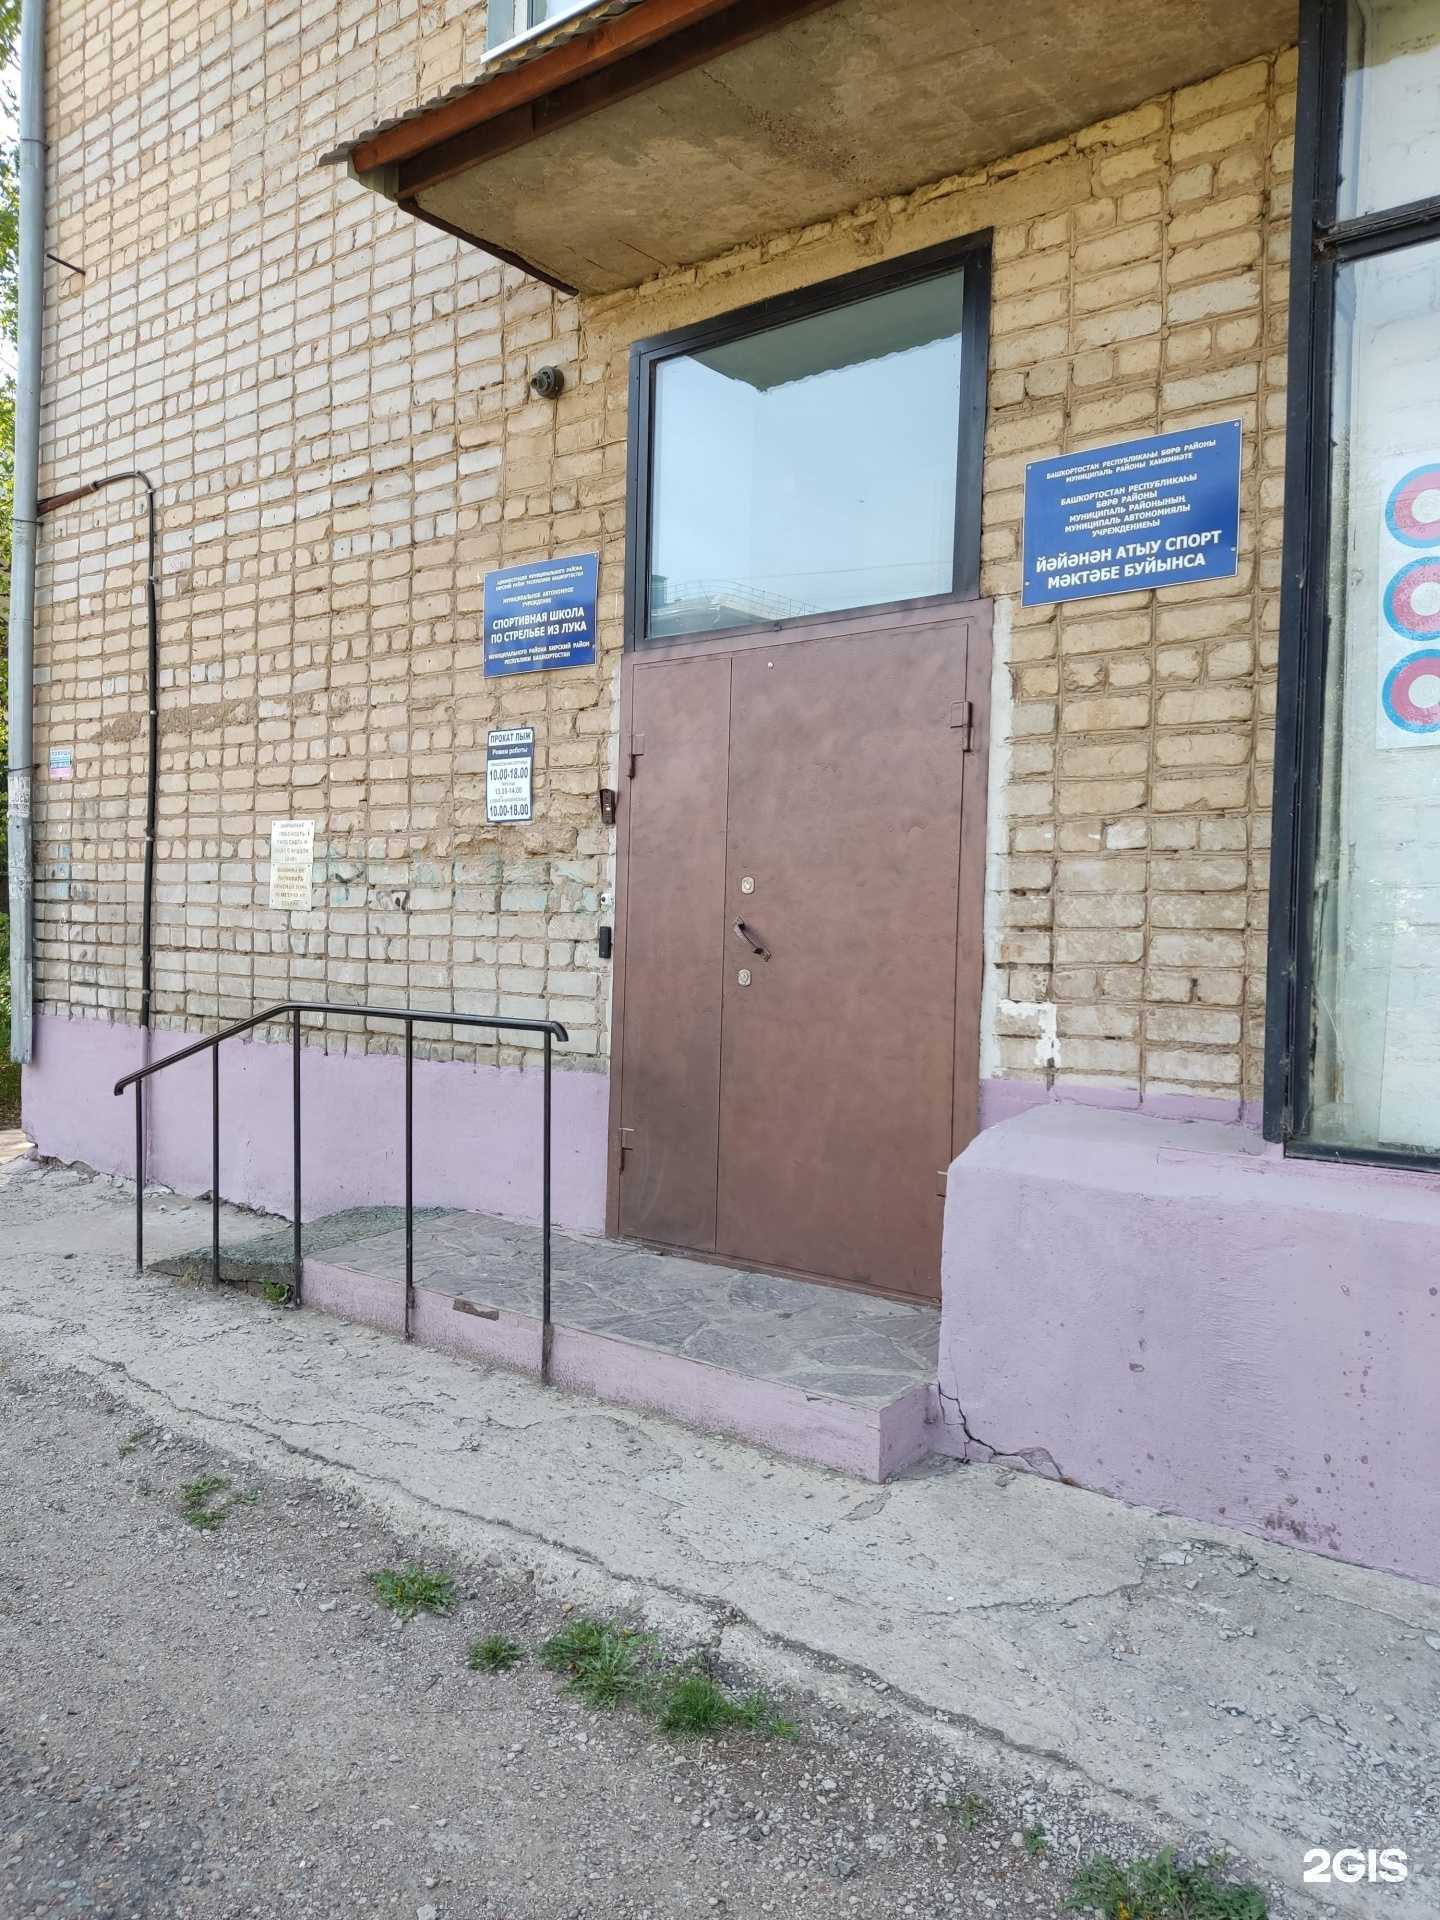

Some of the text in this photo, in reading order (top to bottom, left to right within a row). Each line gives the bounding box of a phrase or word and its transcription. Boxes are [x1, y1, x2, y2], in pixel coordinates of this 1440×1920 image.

[1046, 463, 1099, 480] БАШКОРТОСТАН
[1066, 468, 1113, 483] МУНИЦИПАЛЬ
[1116, 461, 1146, 473] РАЙОНЫ
[1060, 486, 1126, 506] БАШКОРТОСТАН
[1121, 490, 1158, 504] РАЙОНЫ
[1064, 504, 1191, 533] МУНИЦИПАЛЬ АВТОНОМИЯЛЫ
[1069, 507, 1126, 523] МУНИЦИПАЛЬ
[1035, 530, 1222, 573] ЙӘЙӘНӘН АТЫУ СПОРТ
[1048, 553, 1206, 589] МӘКТӘБЕ БУЙЫНСА
[492, 606, 585, 630] СПОРТИВНАЯ ШКОЛА
[491, 621, 587, 644] ПО СТРЕЛЬБЕ ИЗ ЛУКА
[490, 732, 531, 743] ПРОКАТ ЛЫЖ
[490, 766, 529, 781] 10.00-18.00
[490, 803, 529, 817] 10.00-18.00
